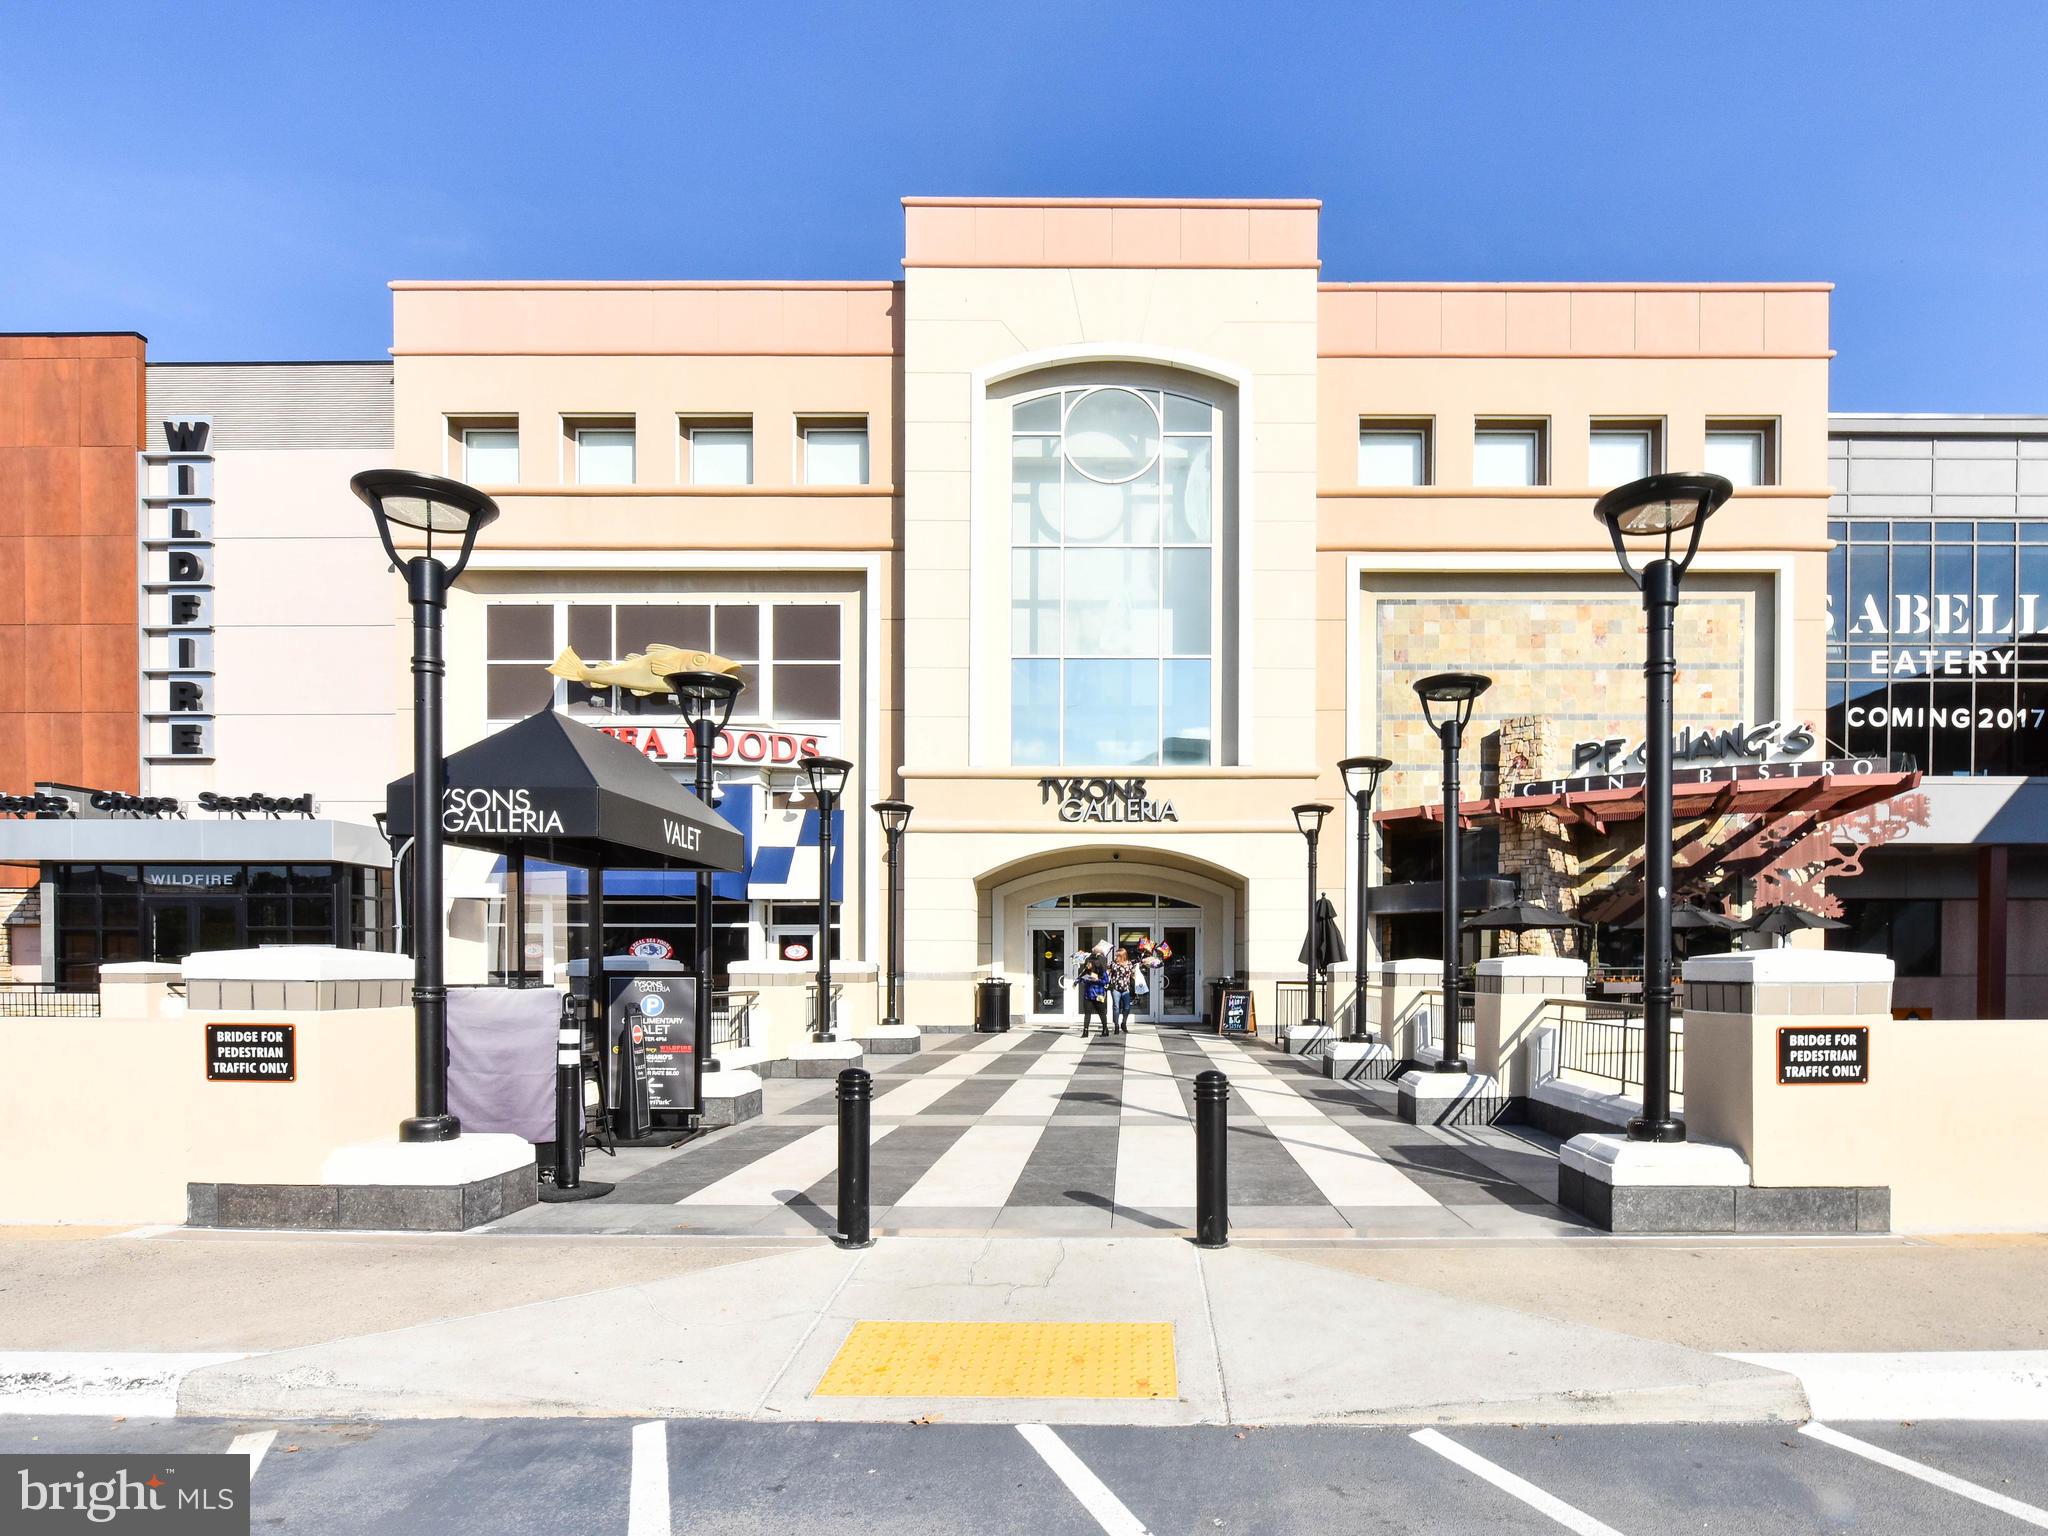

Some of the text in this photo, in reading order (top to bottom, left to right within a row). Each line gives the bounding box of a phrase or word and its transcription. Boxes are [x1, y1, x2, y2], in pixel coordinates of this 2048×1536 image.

[163, 421, 210, 754] WILDFIRE
[1871, 650, 2014, 675] EATERY
[1847, 706, 2045, 729] COMING 2017
[1523, 759, 1875, 798] CHIN BISTRO
[1038, 776, 1147, 805] TYSONS
[90, 790, 180, 815] Chops
[198, 791, 313, 813] Seafood
[1058, 798, 1179, 822] GALLERIA
[442, 808, 565, 833] GALLERIA
[663, 818, 702, 852] VALET
[150, 874, 234, 886] WILDFIRE
[634, 980, 663, 988] TYSONS
[639, 985, 671, 993] GALLERIA
[643, 1025, 670, 1035] ALET
[216, 1031, 284, 1043] BRIDGE FOR
[1789, 1034, 1857, 1046] BRIDGE FOR
[217, 1046, 284, 1058] PEDESTRIAN
[1790, 1049, 1857, 1062] PEDESTRIAN
[212, 1062, 289, 1074] TRAFFIC ONLY
[1784, 1064, 1862, 1077] TRAFFIC ONLY
